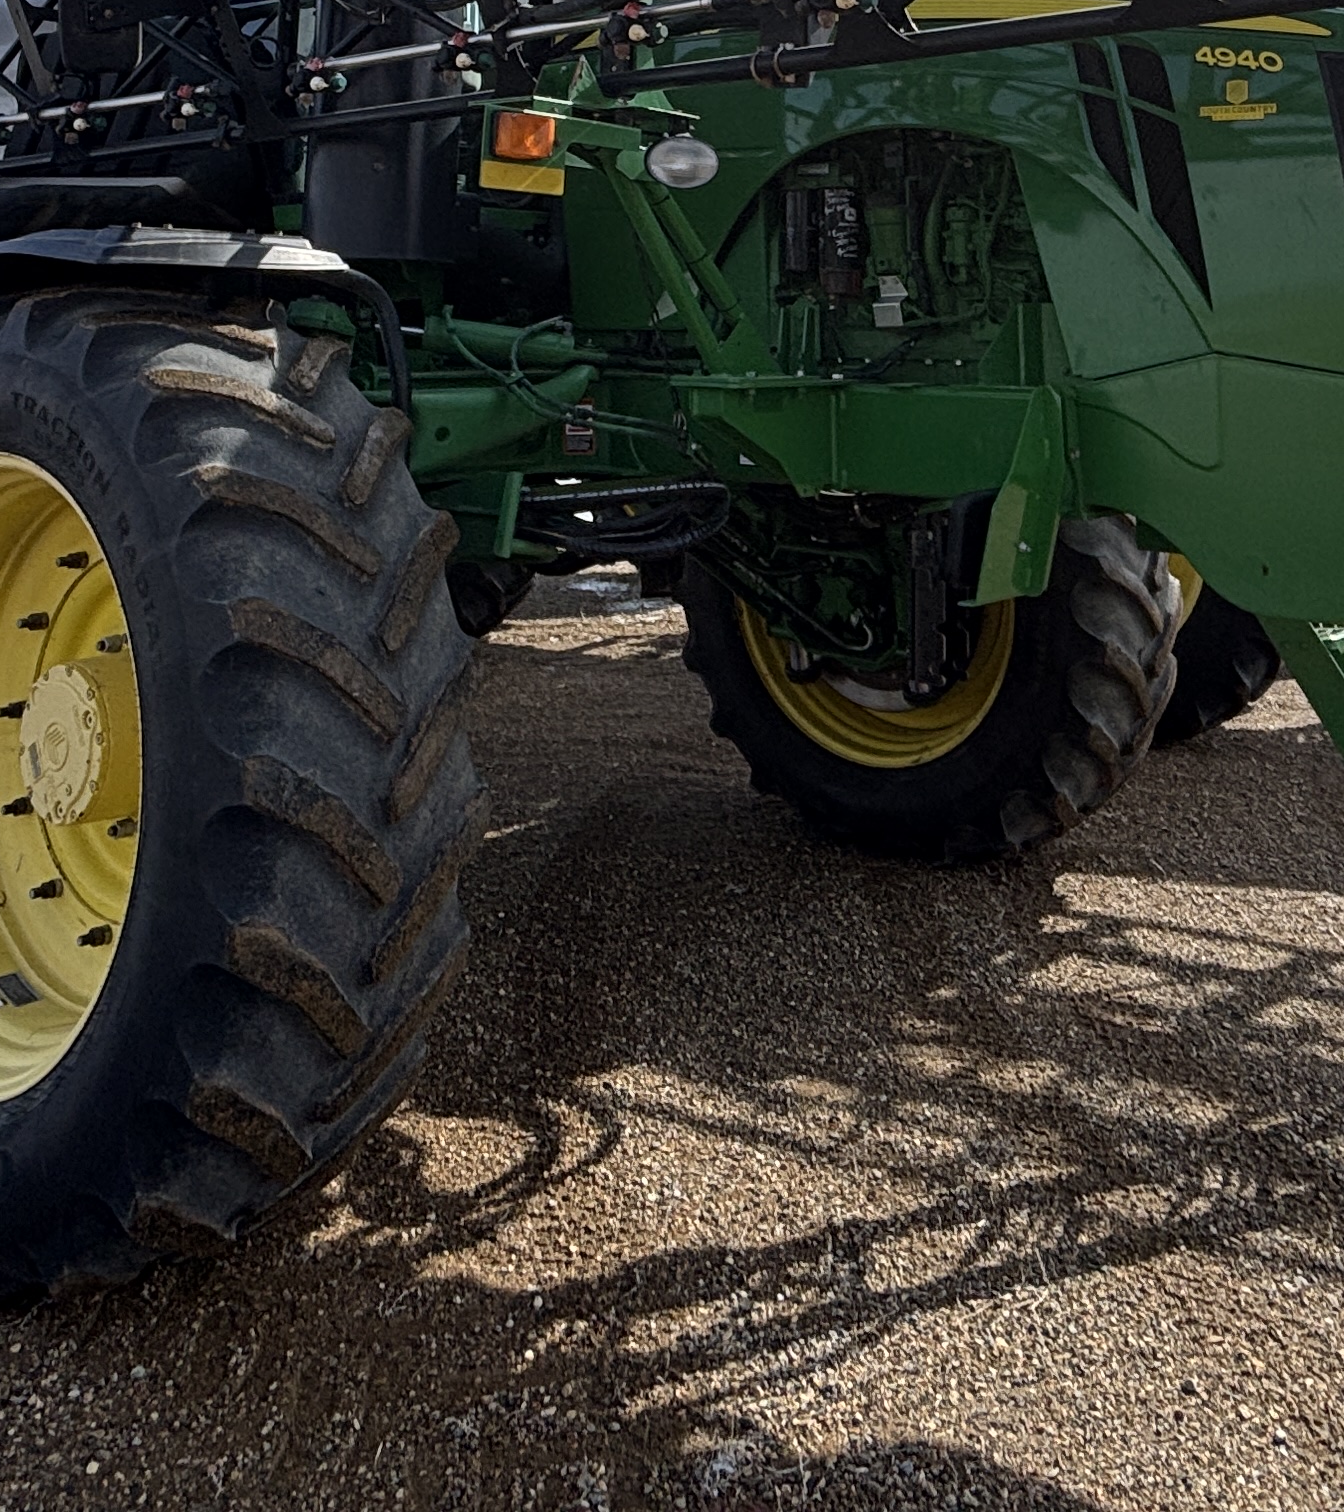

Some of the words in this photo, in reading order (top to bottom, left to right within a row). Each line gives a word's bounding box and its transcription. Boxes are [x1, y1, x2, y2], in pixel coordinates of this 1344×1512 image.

[1195, 46, 1284, 73] 4940
[1231, 104, 1275, 114] COUNTRY
[10, 390, 111, 495] TRACTION
